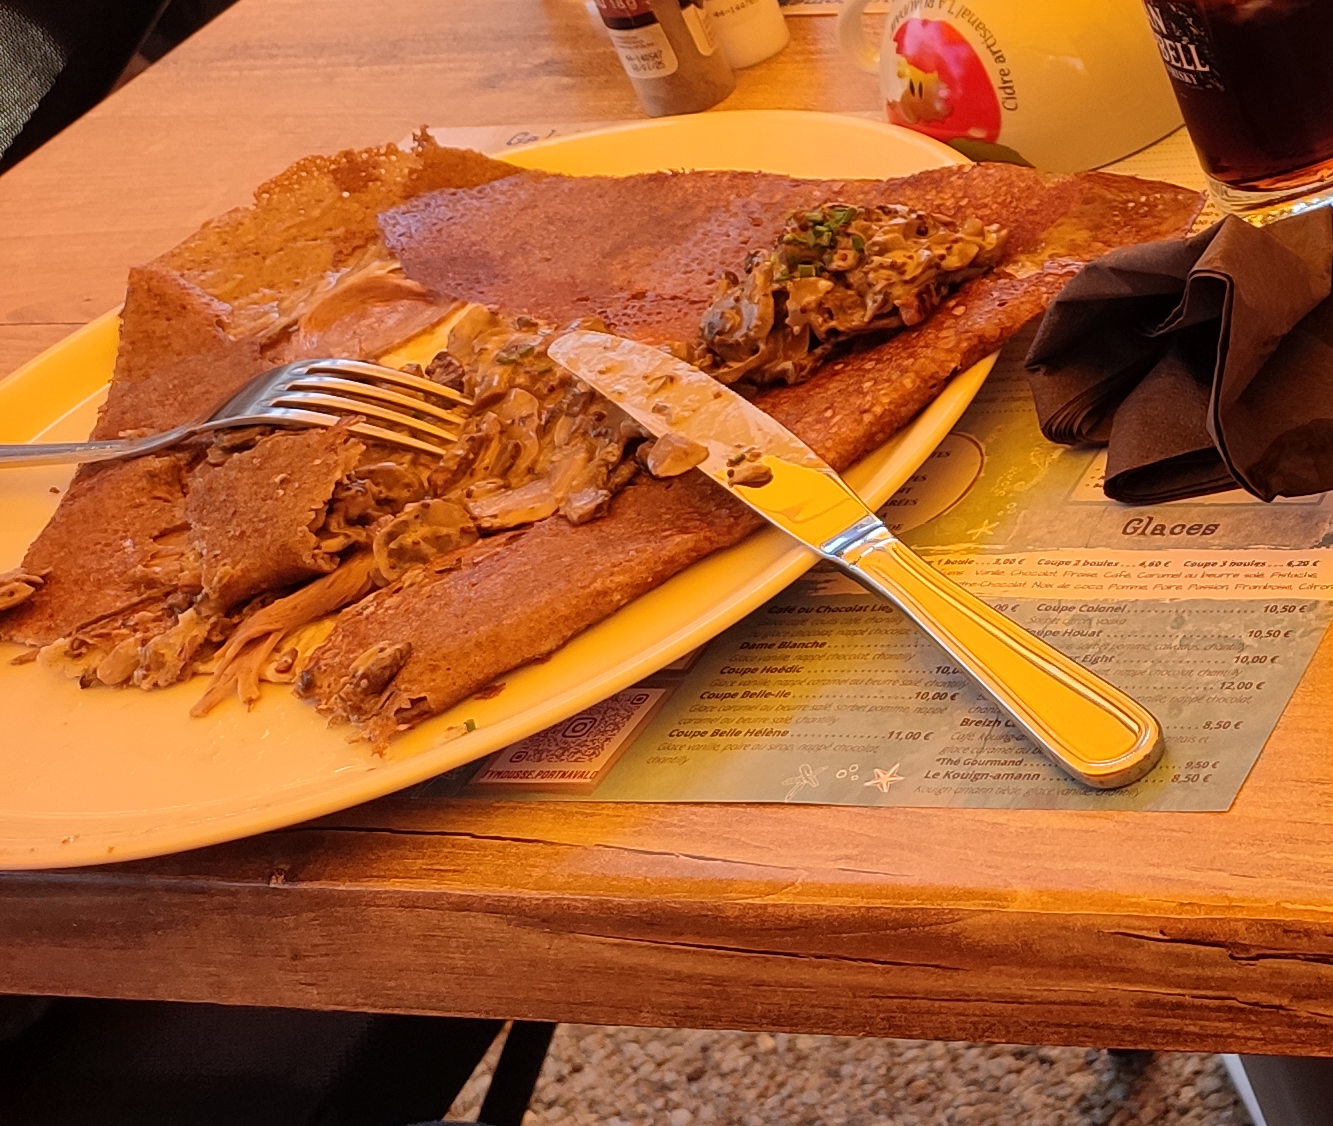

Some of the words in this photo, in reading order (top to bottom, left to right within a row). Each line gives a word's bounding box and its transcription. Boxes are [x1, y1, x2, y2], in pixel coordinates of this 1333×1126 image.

[959, 5, 1006, 64] artisanal
[998, 68, 1018, 111] Cidre
[1122, 517, 1220, 538] Glaces
[1037, 603, 1077, 614] Coupe
[1081, 603, 1126, 613] Colonel
[1263, 604, 1296, 614] 10,50
[1299, 603, 1308, 613] €
[740, 641, 775, 649] Dame
[778, 640, 827, 649] Blanche
[668, 729, 708, 739] Coupe
[712, 728, 743, 737] Belle
[747, 728, 789, 738] Hélène
[888, 731, 922, 741] 11,00
[924, 731, 933, 740] €
[927, 770, 942, 780] Le
[945, 769, 1040, 784] Kouign-amann
[1171, 773, 1201, 784] 8,50
[1203, 773, 1211, 783] €
